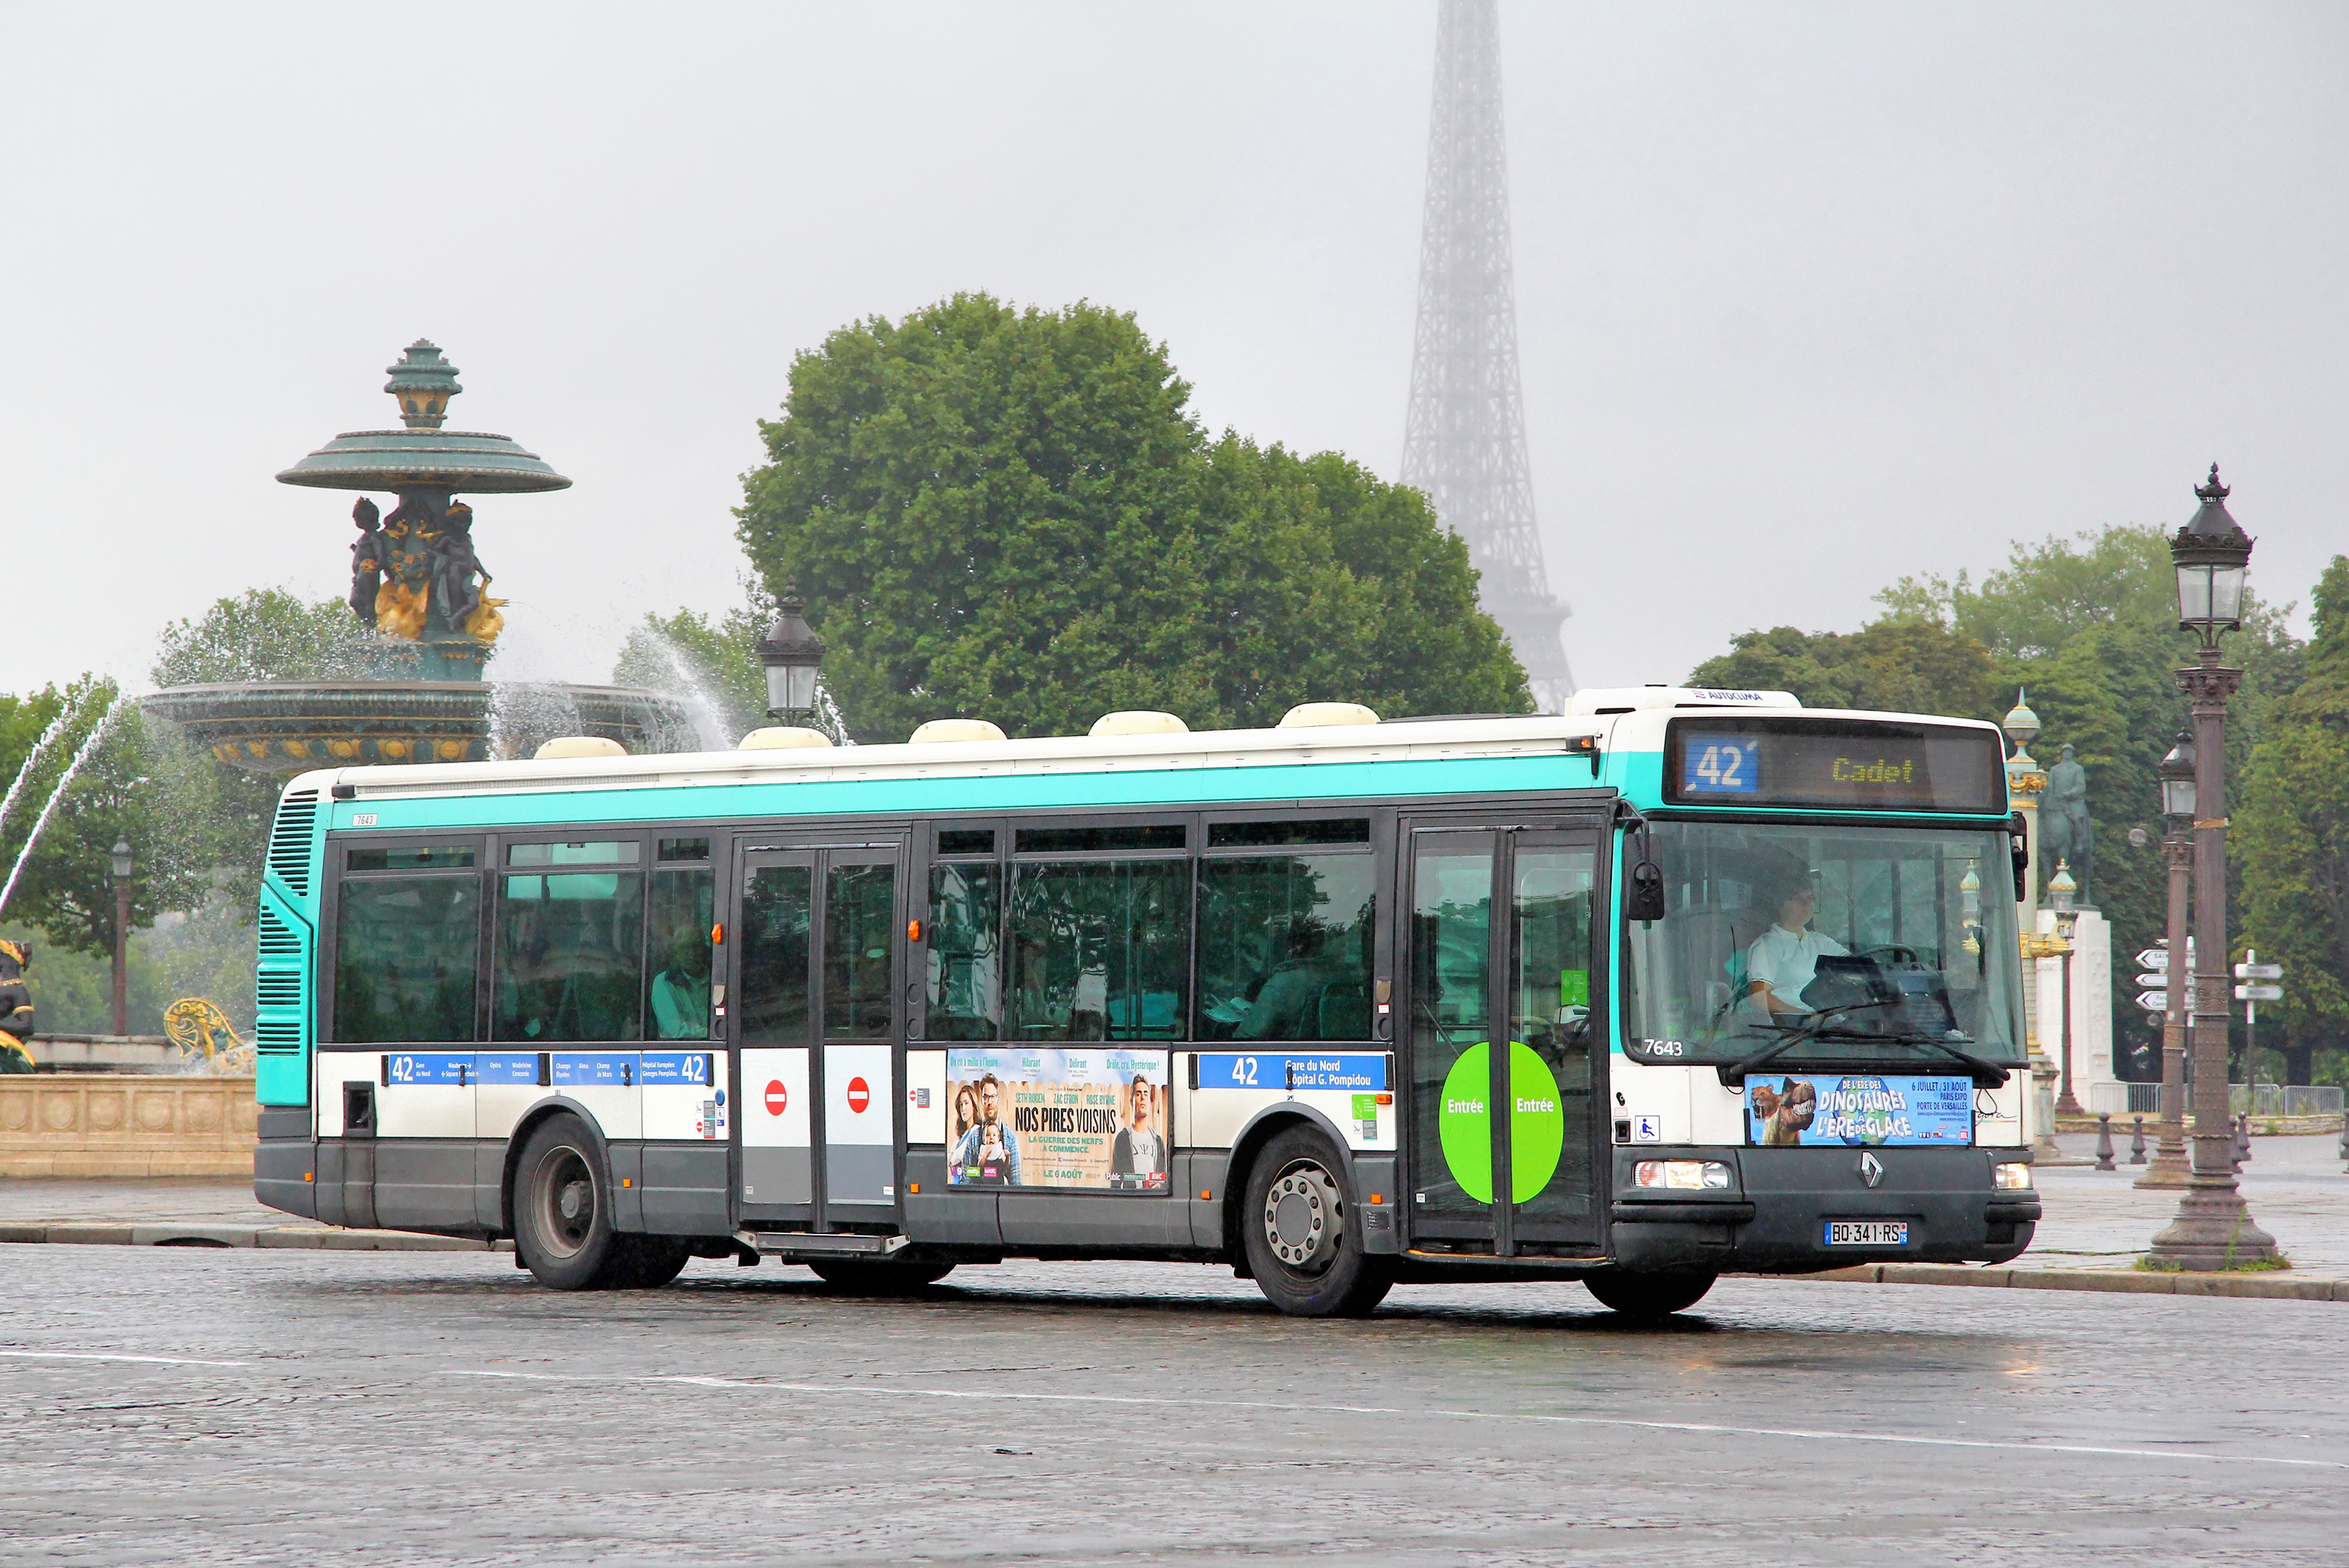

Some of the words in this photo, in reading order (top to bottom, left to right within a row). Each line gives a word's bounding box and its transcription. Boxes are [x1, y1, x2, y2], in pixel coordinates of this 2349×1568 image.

[1707, 691, 1764, 701] AUTOCLIMA
[1697, 745, 1743, 786] 42
[1832, 758, 1913, 783] Cadet
[357, 815, 374, 825] 7643
[1644, 1038, 1684, 1057] 7643
[556, 1062, 571, 1070] Champs
[596, 1062, 611, 1070] Champ
[642, 1061, 656, 1070] Hôpital
[657, 1061, 675, 1070] Européen
[1022, 1057, 1041, 1067] Hilarant
[1069, 1058, 1087, 1068] Délirant
[1106, 1059, 1120, 1070] Drôle,
[1130, 1059, 1156, 1072] Hystérique
[1285, 1059, 1305, 1071] Gare
[1307, 1059, 1318, 1071] du
[1319, 1059, 1340, 1072] Nord
[392, 1056, 414, 1081] 42
[556, 1070, 570, 1078] Élysées
[642, 1070, 658, 1078] Georges
[681, 1055, 705, 1082] 42
[1231, 1056, 1259, 1086] 42
[1318, 1073, 1327, 1085] G.
[1329, 1073, 1371, 1088] Pompidou
[1842, 1080, 1851, 1090] DE
[1851, 1079, 1869, 1090] L'ÈRE
[1869, 1080, 1882, 1090] DES
[1911, 1081, 1916, 1092] 6
[1917, 1081, 1939, 1092] JUILLET
[1942, 1081, 1950, 1092] 31
[1951, 1079, 1967, 1092] AOÛT
[1015, 1092, 1028, 1103] SETH
[1028, 1092, 1045, 1103] ROGEN
[1053, 1093, 1064, 1104] ZAC
[1064, 1093, 1079, 1104] EFRON
[1086, 1094, 1098, 1105] ROSE
[1099, 1094, 1116, 1106] BYRNE
[1818, 1089, 1909, 1114] DINOSAURES
[1940, 1092, 1953, 1101] PARIS
[1955, 1092, 1967, 1101] EXPO
[1448, 1097, 1484, 1114] Entrée
[1516, 1097, 1554, 1112] Entrée
[1917, 1102, 1933, 1110] PORTE
[1934, 1102, 1941, 1110] DE
[1942, 1102, 1968, 1111] VERSAILLES
[1014, 1106, 1039, 1132] NOS
[1041, 1107, 1075, 1133] PIRES
[1076, 1108, 1117, 1134] VOISINS
[1858, 1113, 1865, 1123] À
[1815, 1111, 1856, 1139] L'ÈRE
[1855, 1124, 1867, 1136] DE
[1866, 1116, 1914, 1139] GLACE
[1039, 1136, 1066, 1144] GUERRE
[1067, 1136, 1081, 1144] DES
[1081, 1137, 1103, 1145] NERFS
[1043, 1169, 1053, 1177] LE
[1054, 1170, 1059, 1178] 6
[1061, 1169, 1083, 1179] AOÛT
[1105, 1172, 1122, 1180] Public
[1900, 1234, 1908, 1242] 75
